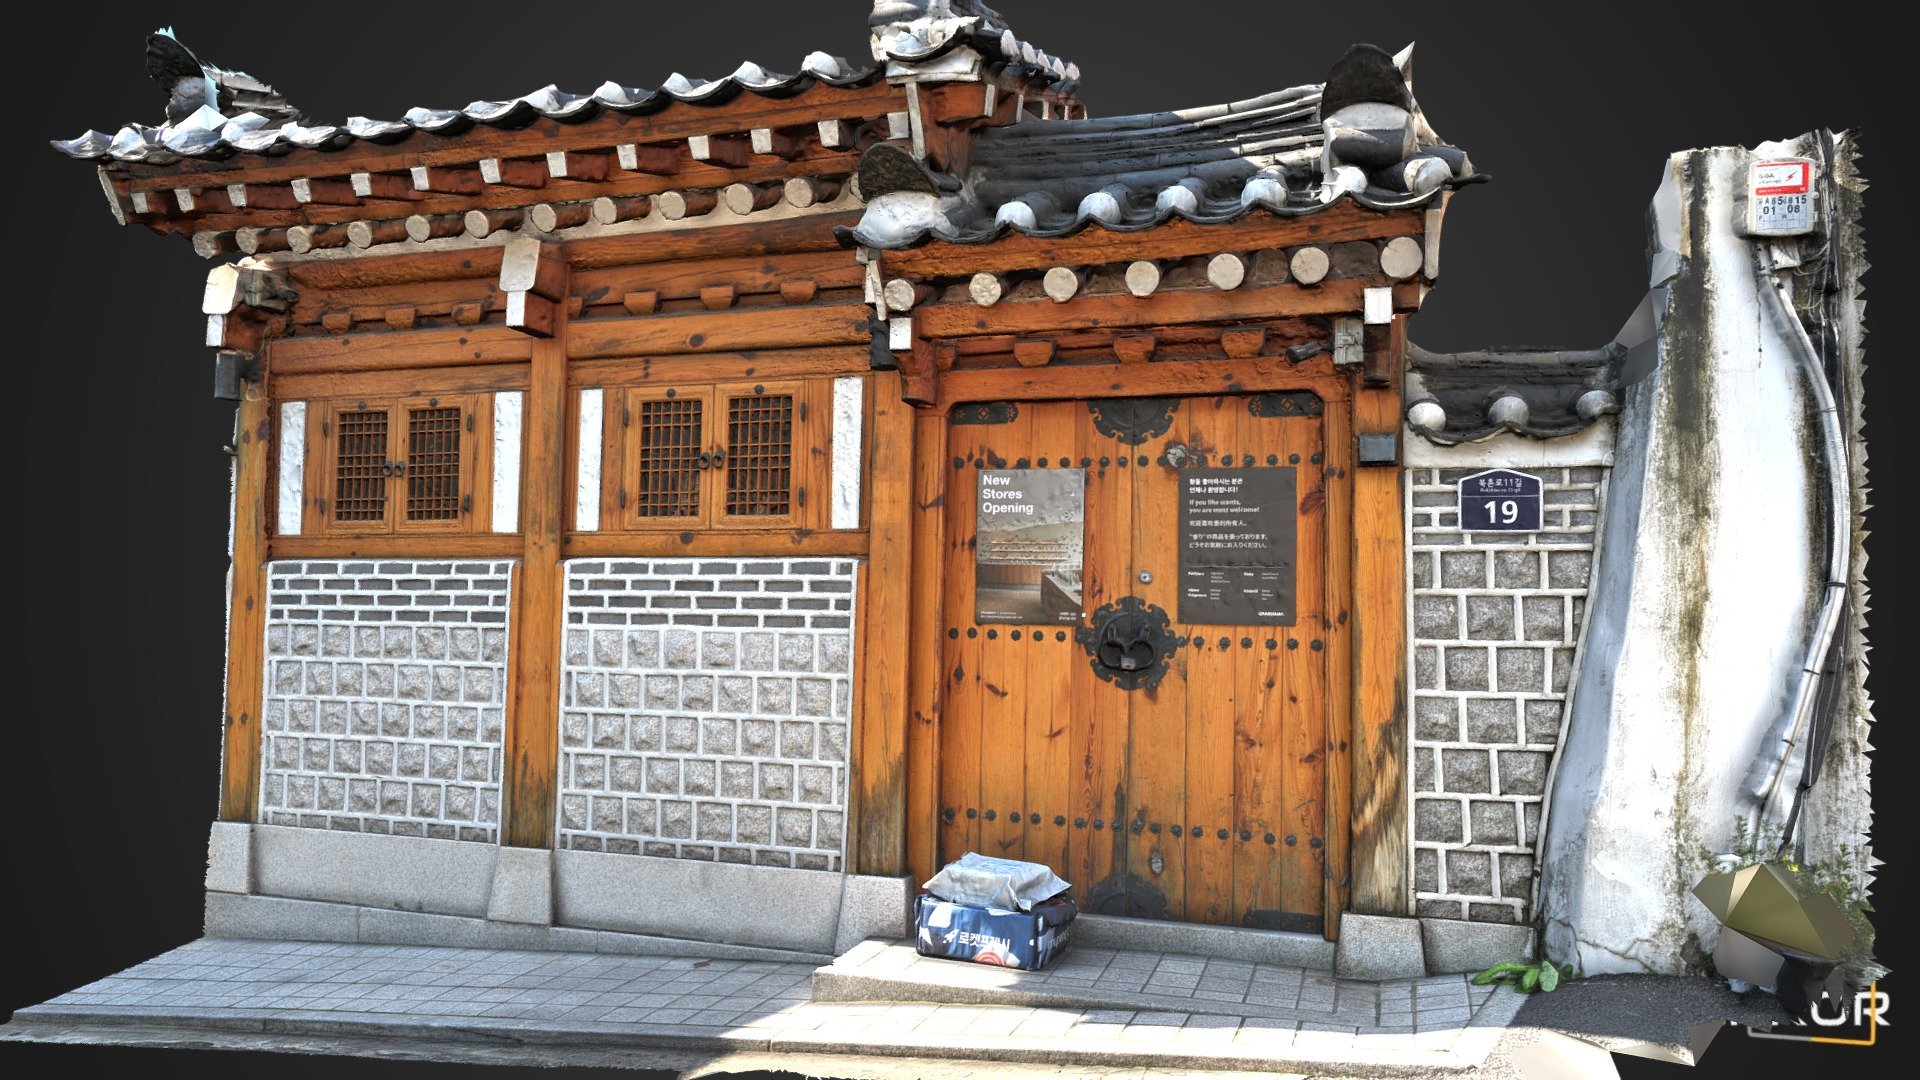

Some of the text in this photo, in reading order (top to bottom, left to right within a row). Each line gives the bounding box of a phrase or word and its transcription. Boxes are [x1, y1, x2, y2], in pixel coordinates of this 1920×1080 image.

[983, 475, 1011, 486] New
[1478, 478, 1523, 488] 북촌로11길
[982, 489, 1023, 499] Stores
[982, 502, 1034, 515] Opening
[1484, 500, 1519, 524] 19
